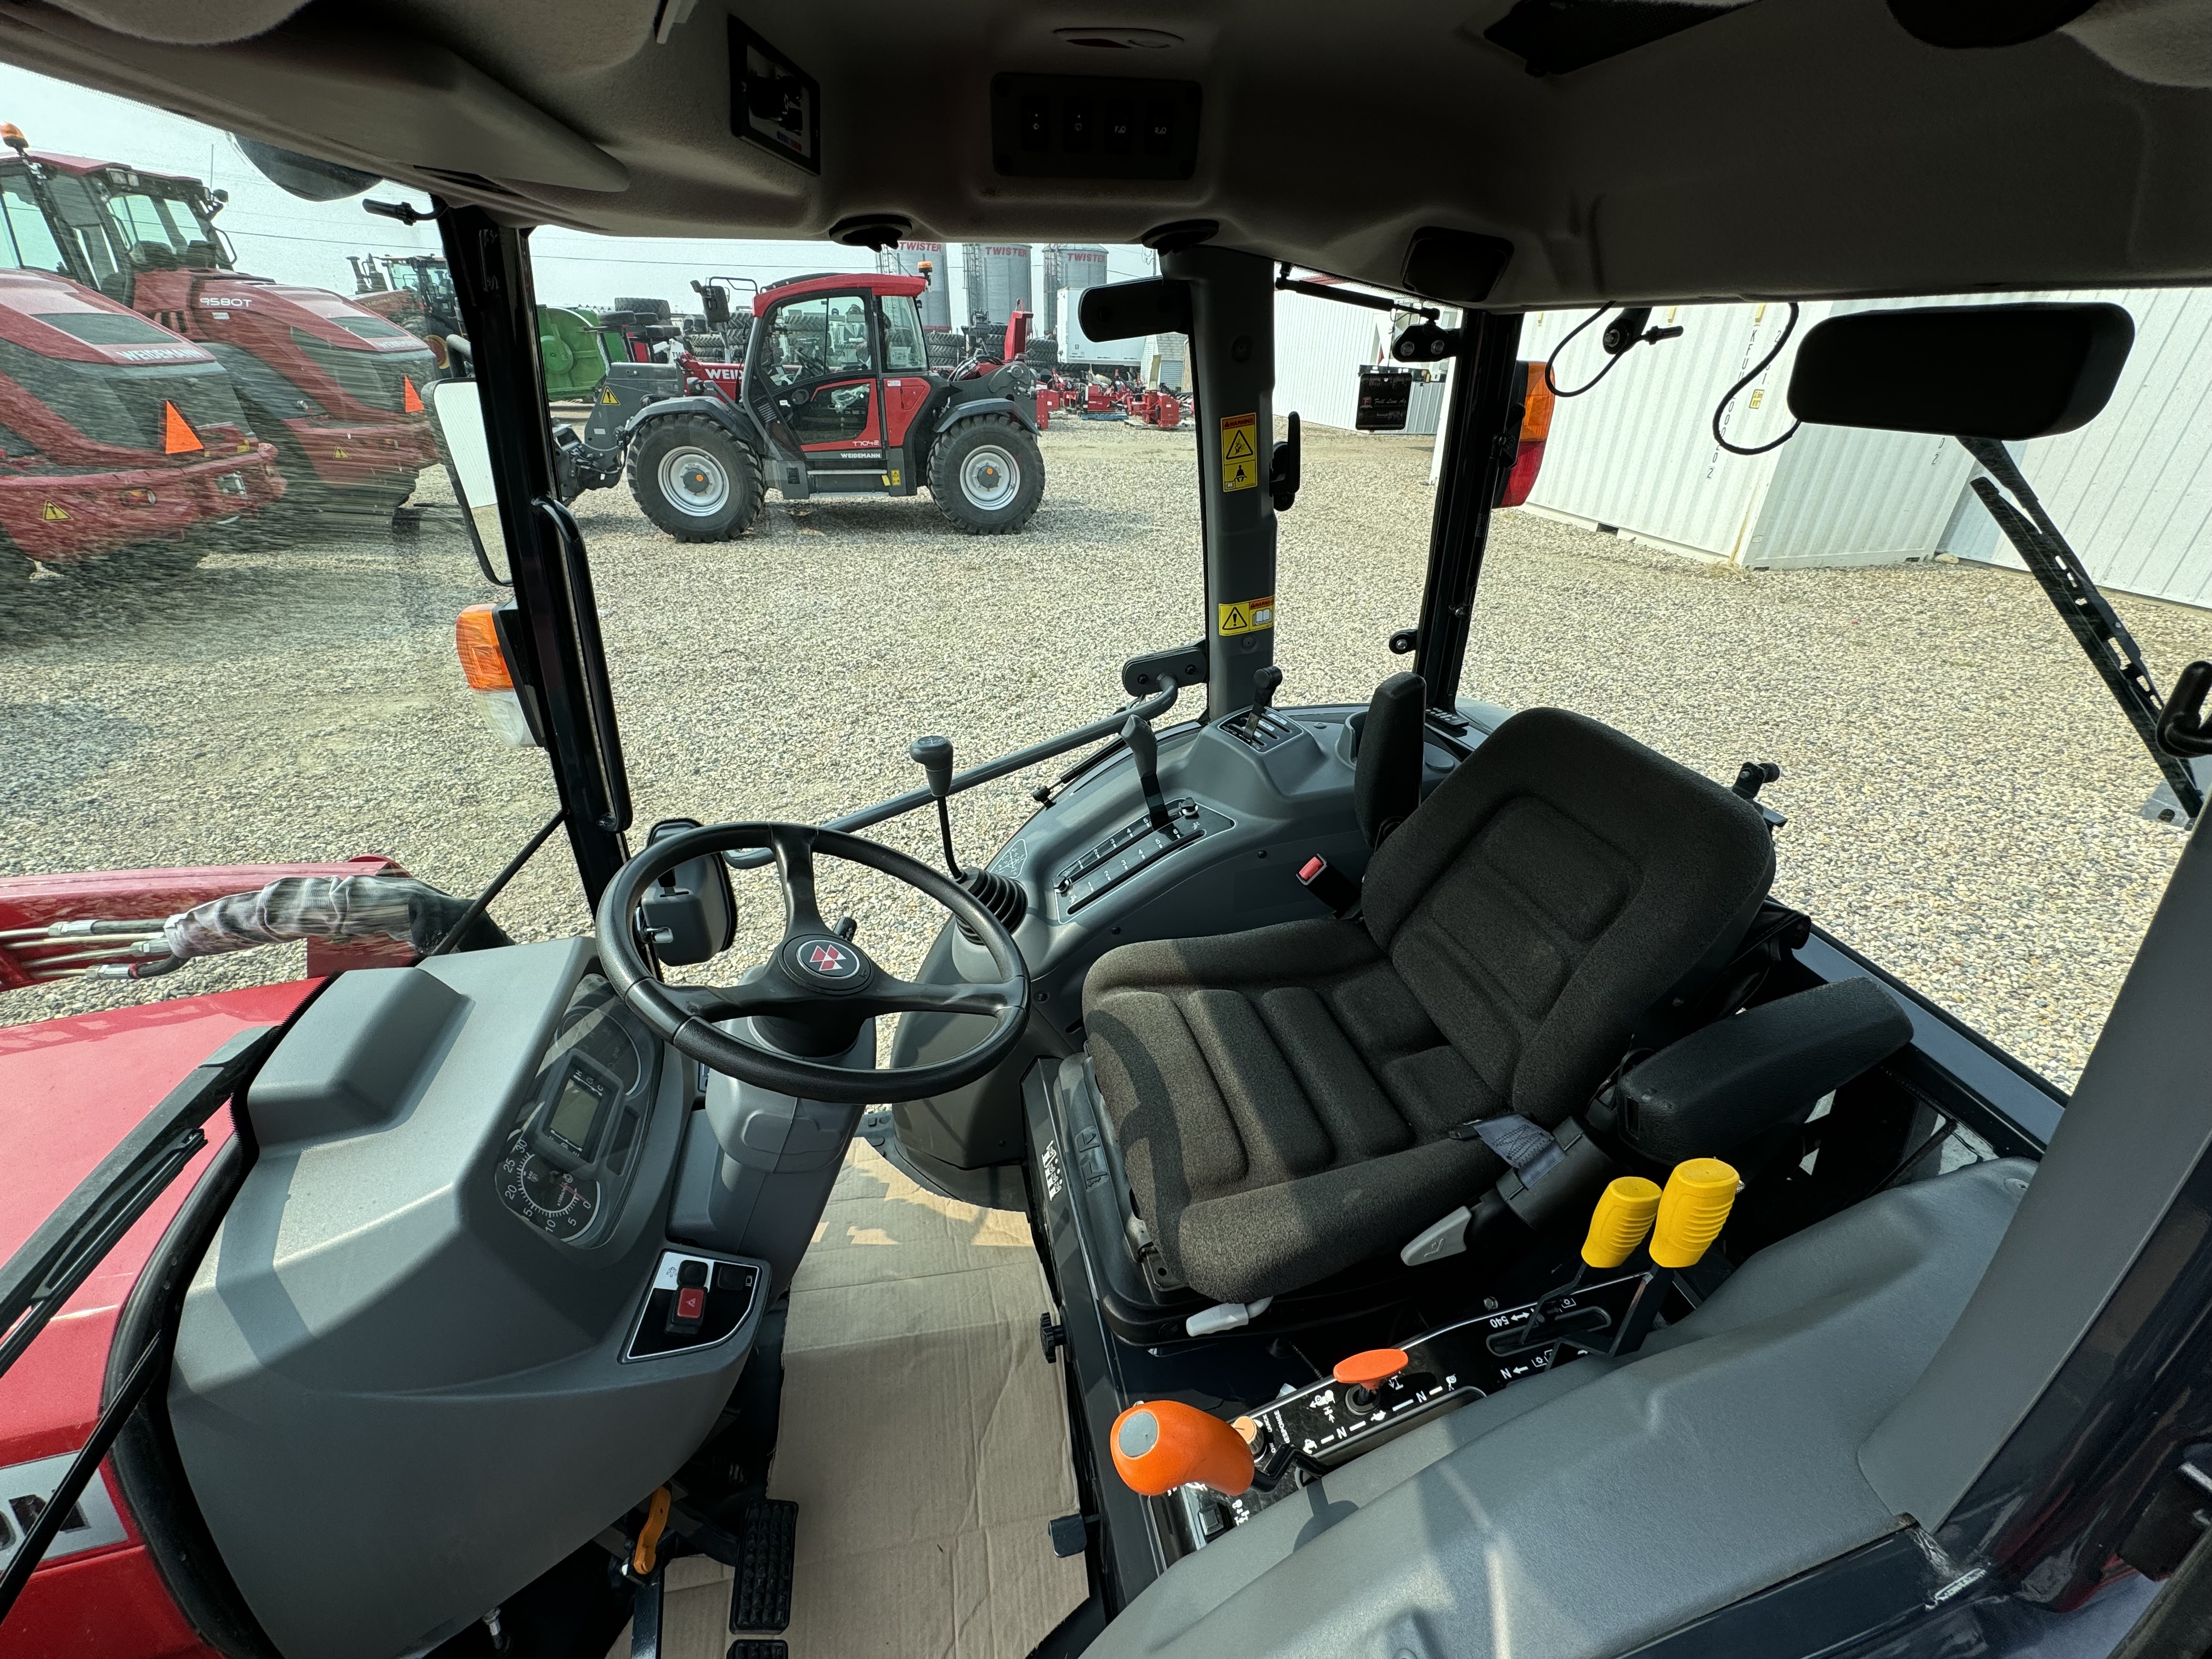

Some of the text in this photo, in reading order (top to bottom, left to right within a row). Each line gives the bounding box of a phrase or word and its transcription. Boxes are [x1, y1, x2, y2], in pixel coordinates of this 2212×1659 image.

[898, 242, 942, 252] TWISTER
[985, 246, 1028, 258] TWISTER
[1067, 252, 1106, 263] TWISTER
[200, 297, 252, 308] 9580T
[1229, 417, 1254, 427] WARNING
[516, 1139, 527, 1153] 30
[503, 1158, 516, 1173] 25
[505, 1184, 517, 1200] 20
[583, 1201, 591, 1209] 0
[545, 1220, 556, 1233] 10
[567, 1217, 577, 1227] 5
[1489, 1316, 1510, 1329] 540
[1500, 1368, 1512, 1380] N
[1415, 1390, 1427, 1403] N
[1262, 1413, 1273, 1433] QUICK
[1336, 1426, 1347, 1440] N
